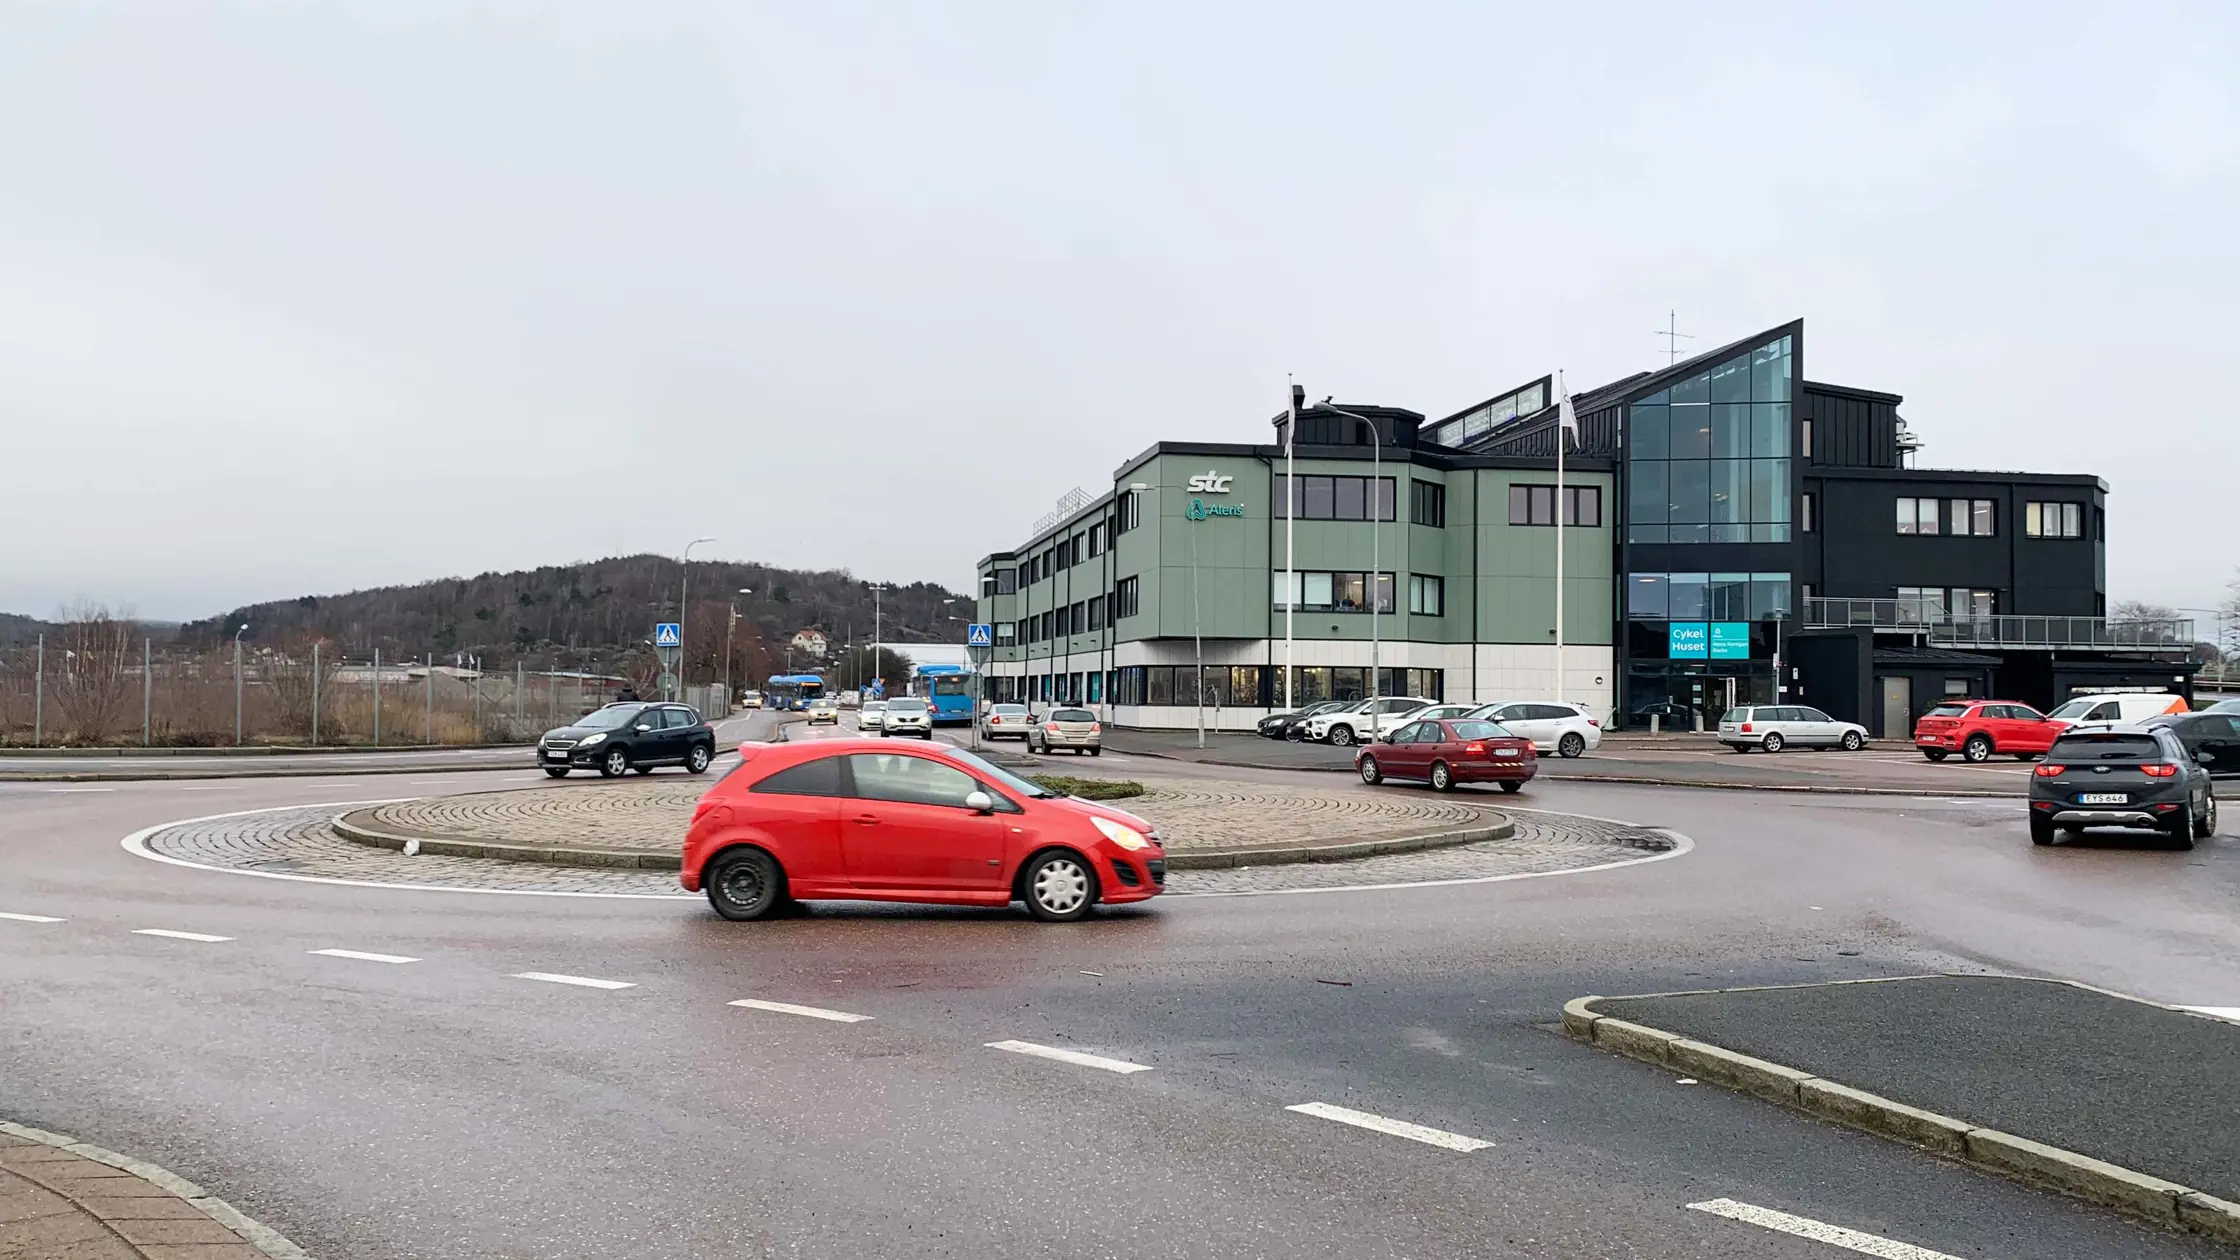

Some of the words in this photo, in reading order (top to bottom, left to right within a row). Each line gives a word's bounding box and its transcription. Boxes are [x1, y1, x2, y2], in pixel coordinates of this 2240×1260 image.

[1187, 470, 1233, 493] stc
[1209, 504, 1243, 516] Aleris
[1673, 629, 1704, 640] Cykel
[1673, 642, 1705, 651] Huset
